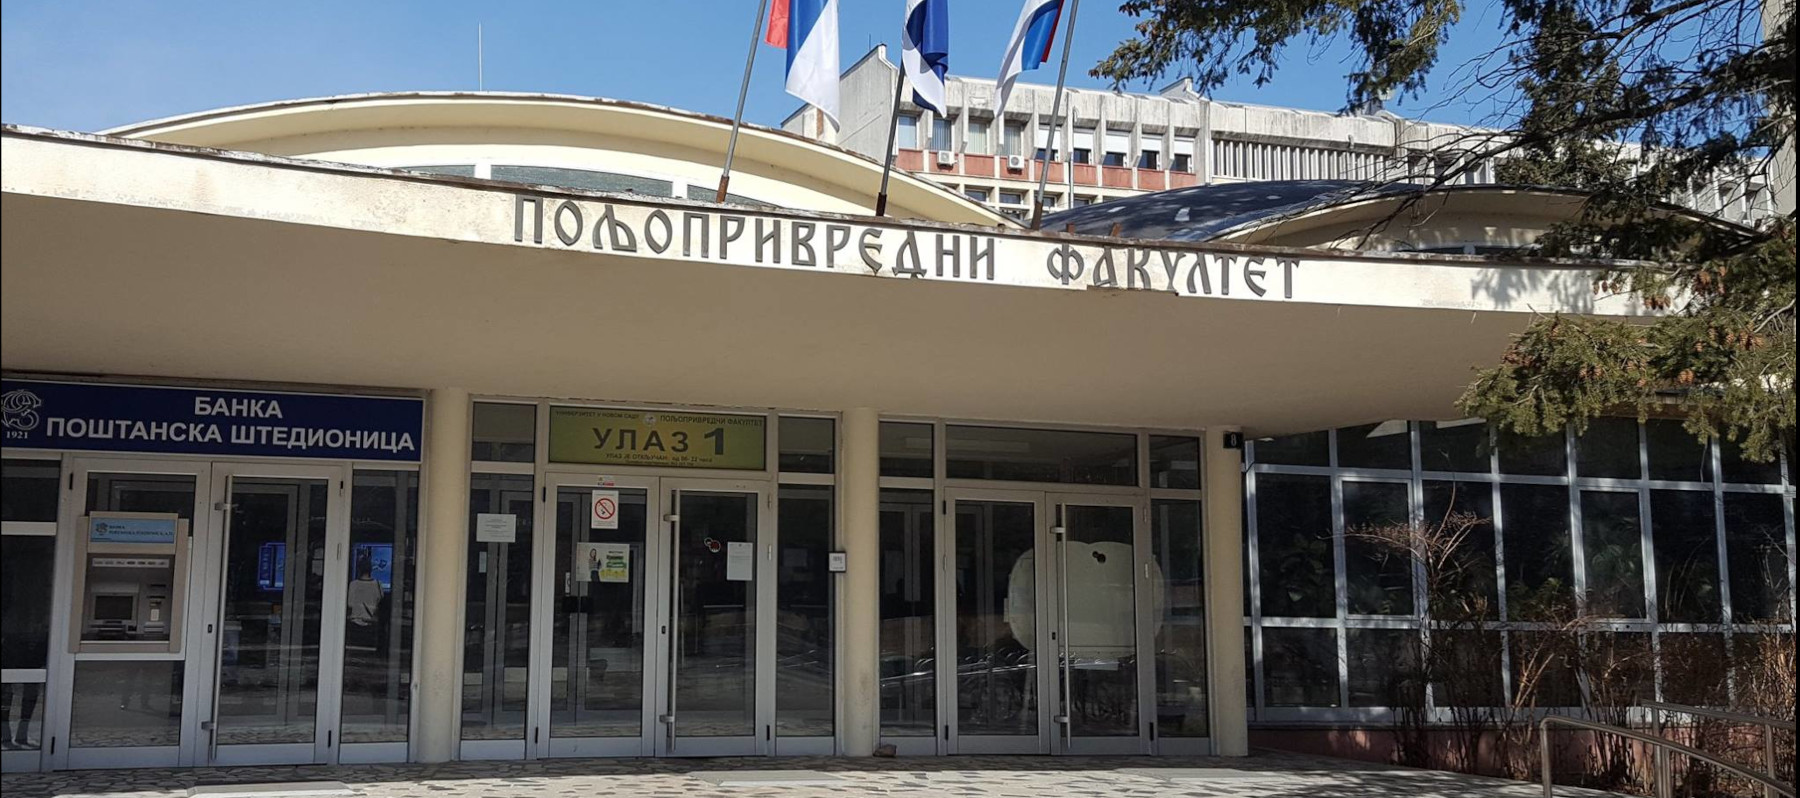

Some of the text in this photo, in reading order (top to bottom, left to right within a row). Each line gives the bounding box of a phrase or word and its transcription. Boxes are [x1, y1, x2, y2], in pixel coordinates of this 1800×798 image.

[514, 193, 1301, 299] ПОЉОПРИВРЕДНИ ФАКУЛТЕТ
[194, 396, 283, 420] БАНКА
[727, 417, 763, 427] ФАКУЛТЕТ
[6, 430, 29, 440] 1921
[46, 417, 415, 453] ПОШТАНСКА ШТЕДИОНИЦА
[592, 427, 725, 456] УЛАЗ 1
[1231, 433, 1237, 446] 8
